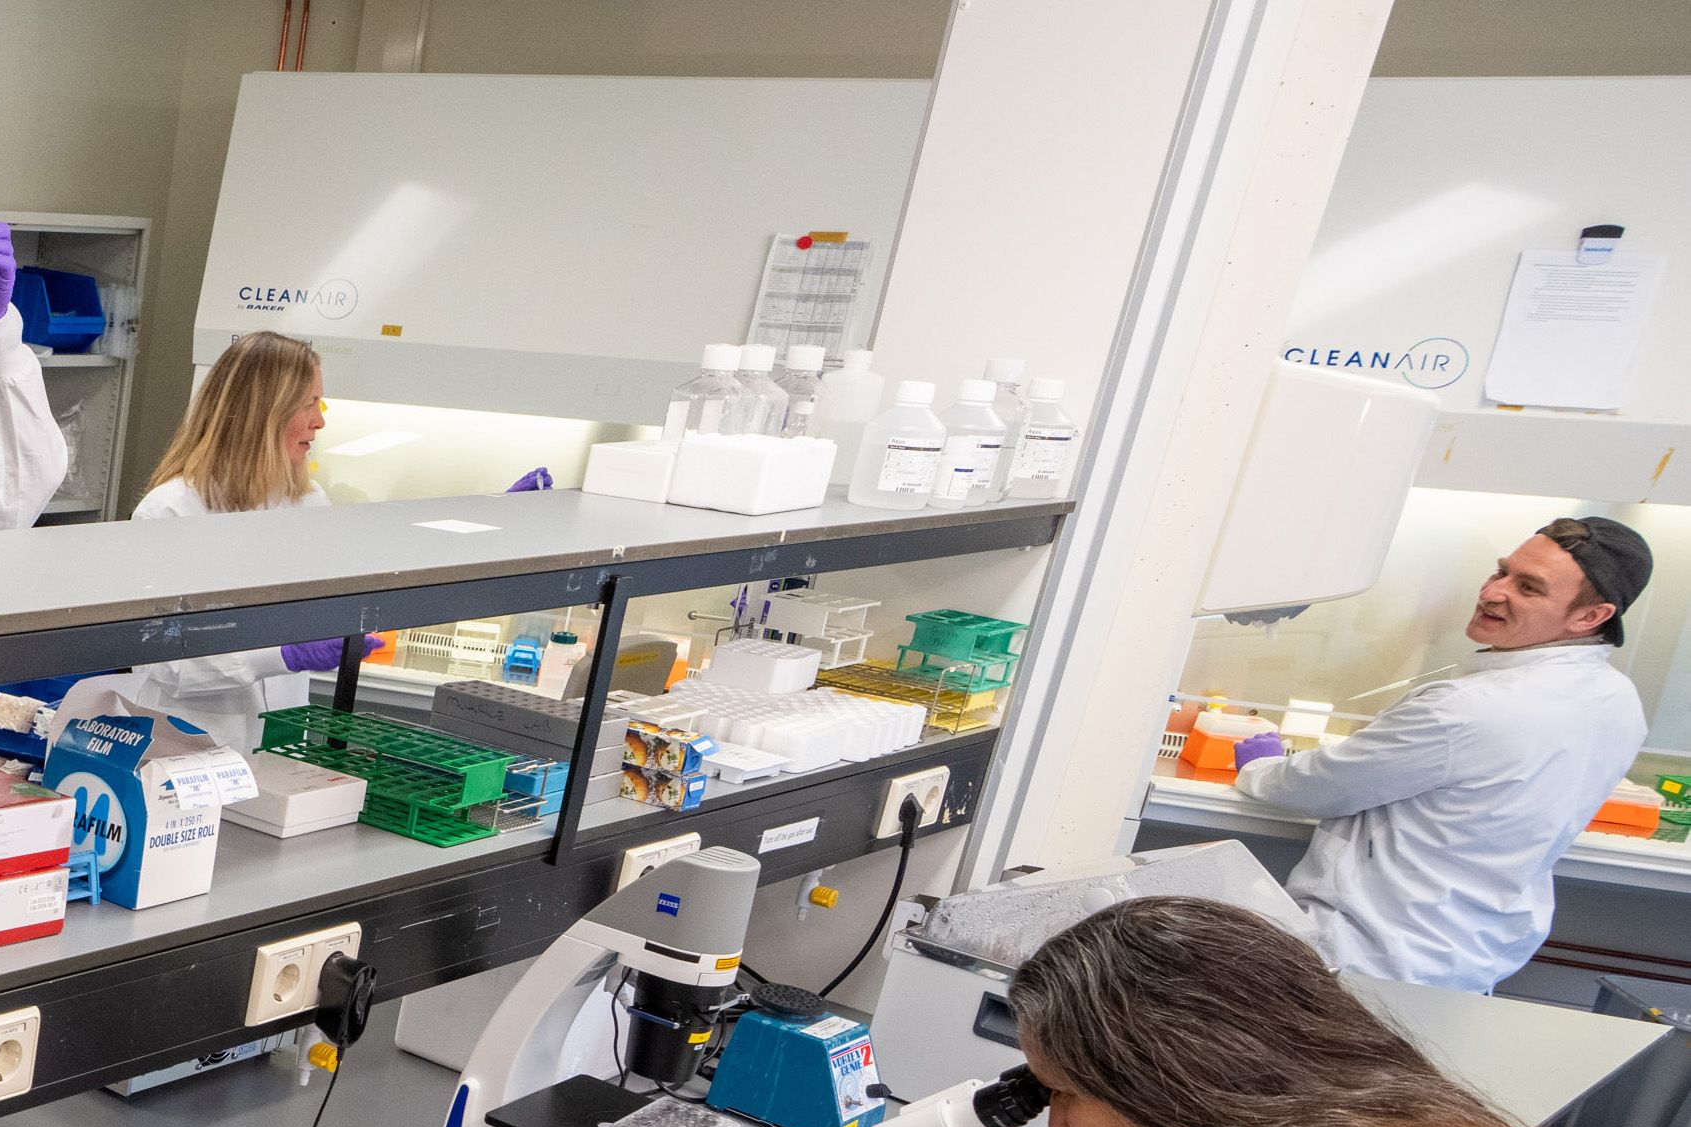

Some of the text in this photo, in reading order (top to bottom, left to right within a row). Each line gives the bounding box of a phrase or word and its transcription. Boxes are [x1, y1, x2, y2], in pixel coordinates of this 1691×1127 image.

[246, 304, 285, 312] BAKER
[76, 719, 144, 747] LABORATORY
[86, 737, 114, 756] FILM
[73, 811, 122, 843] AFILM
[149, 832, 179, 848] DOUBLE
[180, 828, 196, 842] SIZE
[198, 824, 215, 839] ROLL
[658, 898, 679, 909] ZEISS
[832, 1050, 861, 1068] VORTEX
[860, 1045, 873, 1068] 2
[840, 1062, 862, 1076] GENIE
